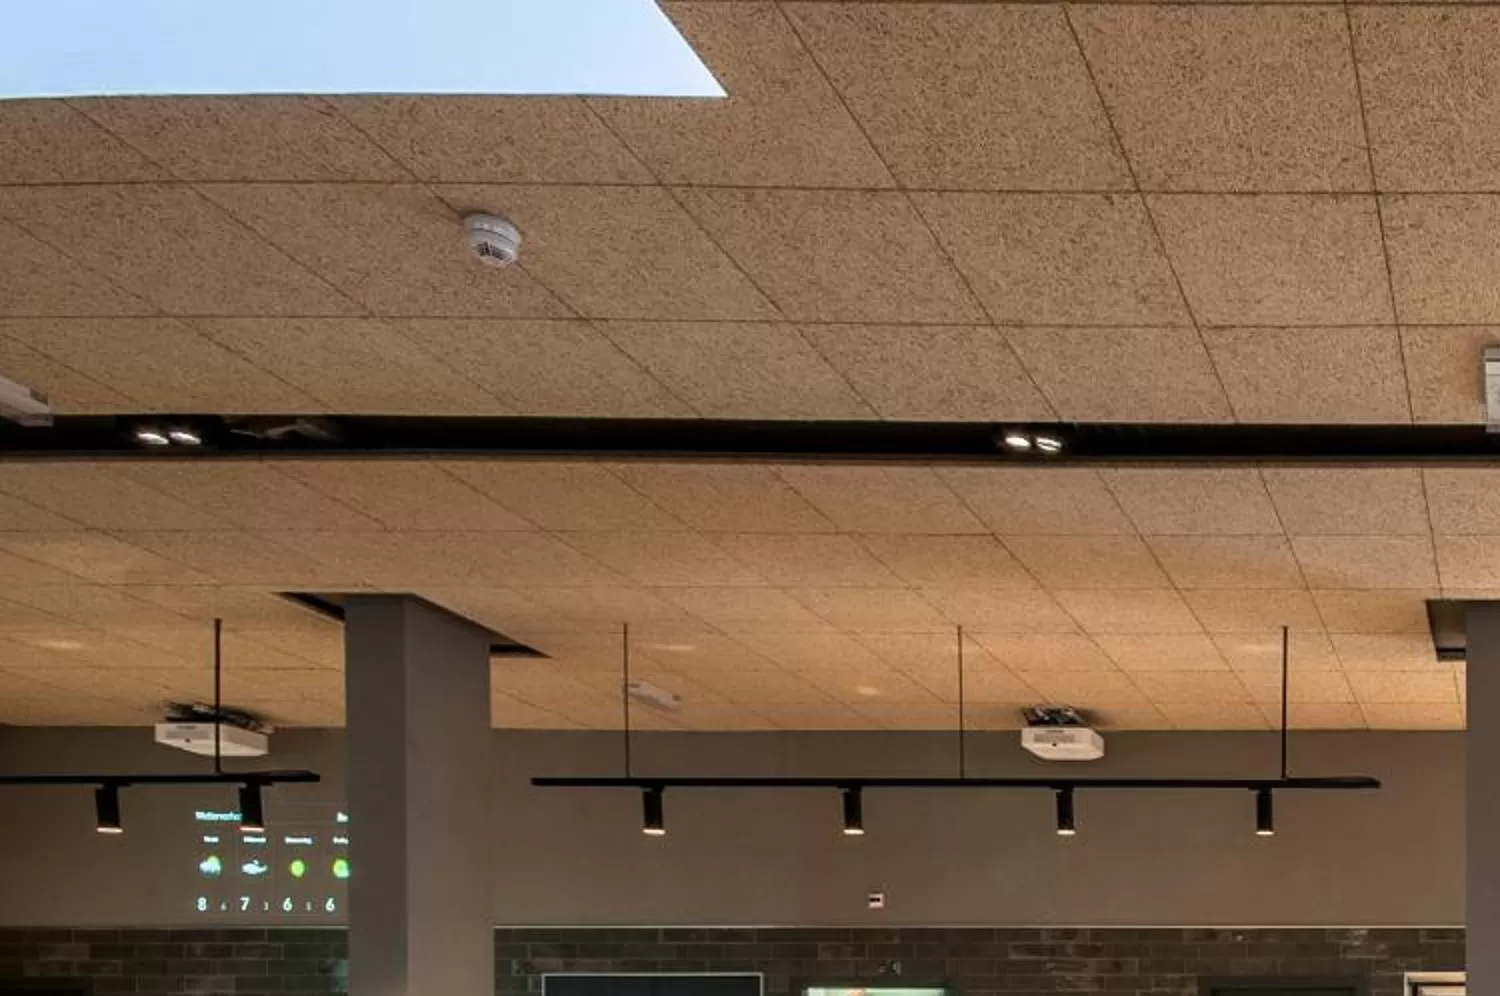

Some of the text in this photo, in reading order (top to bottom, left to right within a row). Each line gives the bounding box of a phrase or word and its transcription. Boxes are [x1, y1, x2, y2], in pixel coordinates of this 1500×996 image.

[197, 897, 207, 911] 8
[240, 896, 251, 911] 7
[283, 897, 293, 911] 6
[325, 897, 336, 911] 6
